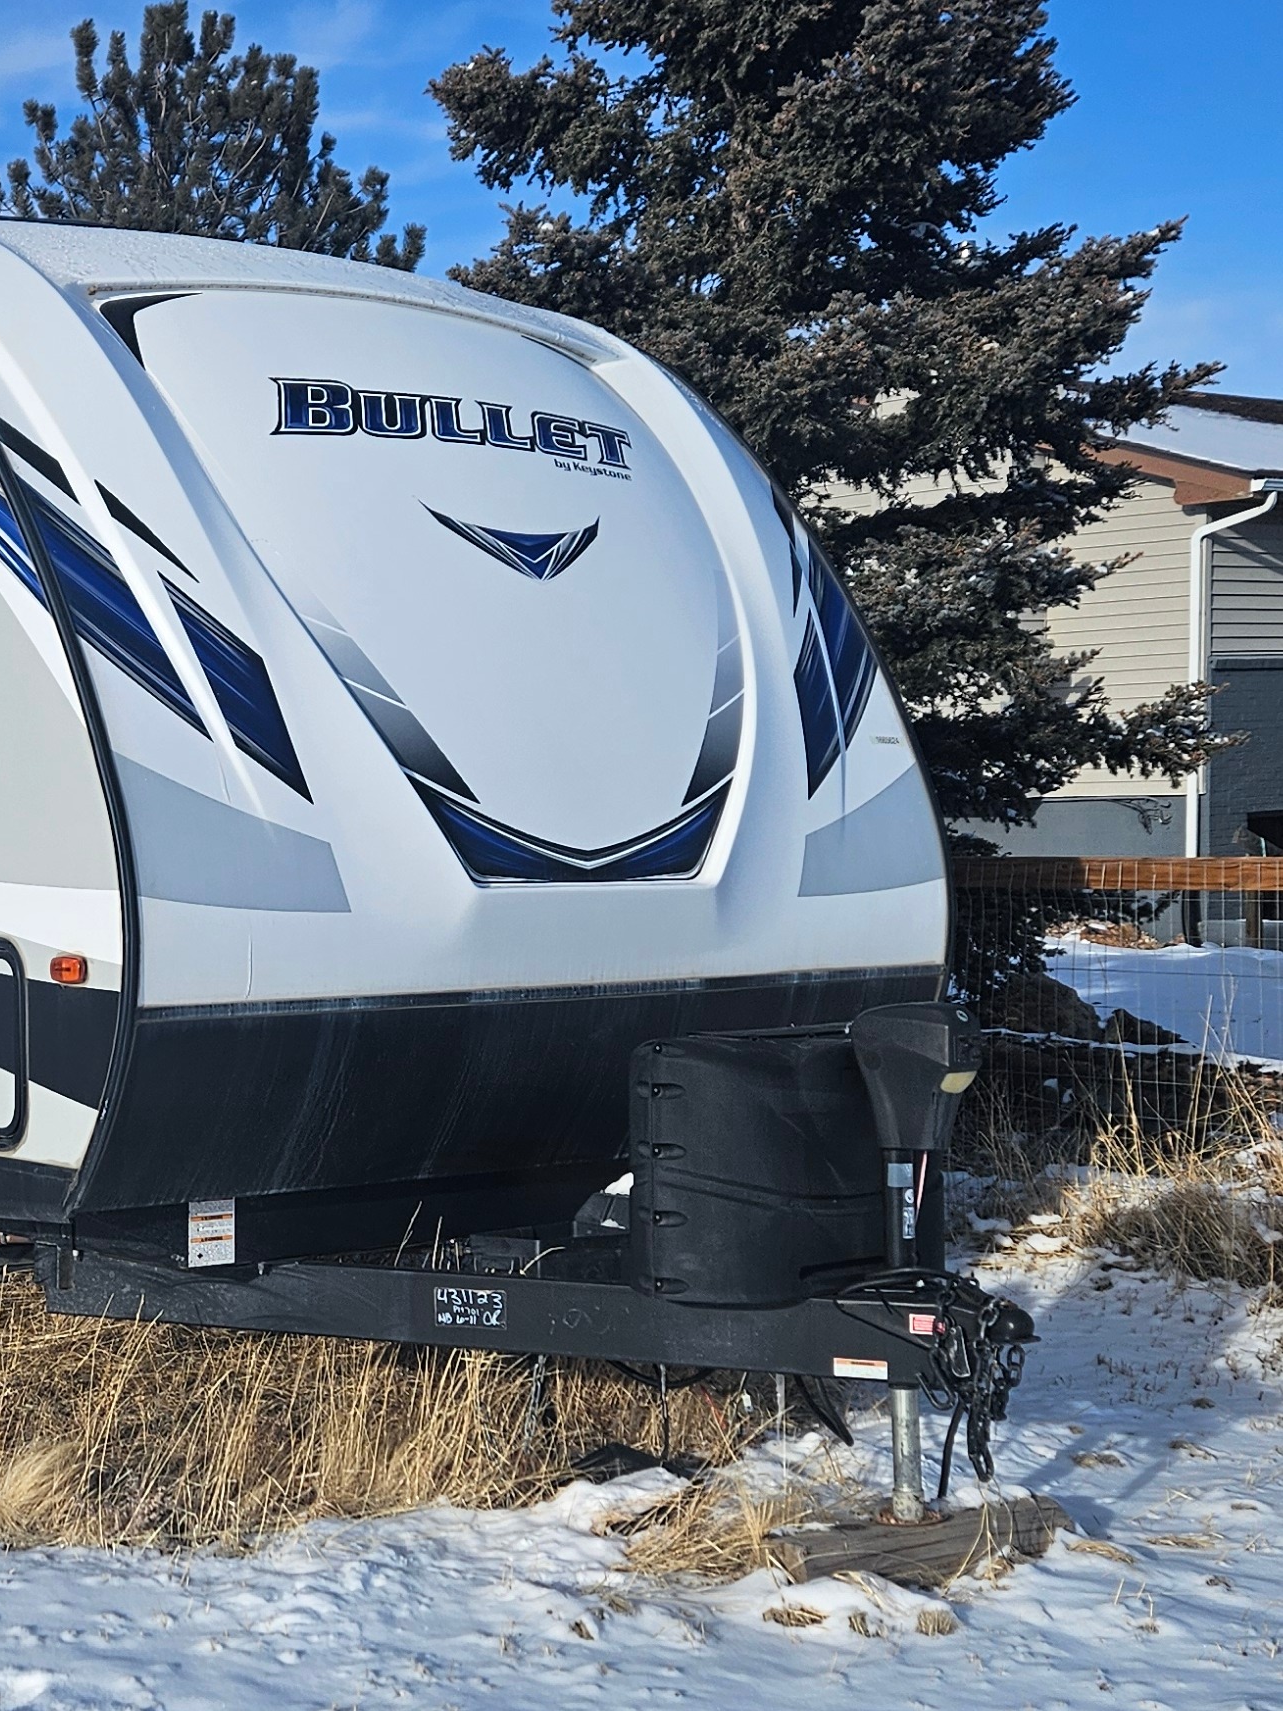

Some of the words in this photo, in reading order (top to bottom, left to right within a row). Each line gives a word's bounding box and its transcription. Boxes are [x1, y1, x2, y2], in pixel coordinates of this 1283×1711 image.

[553, 458, 571, 471] by
[573, 461, 632, 481] Keystone
[437, 1289, 503, 1309] 431123
